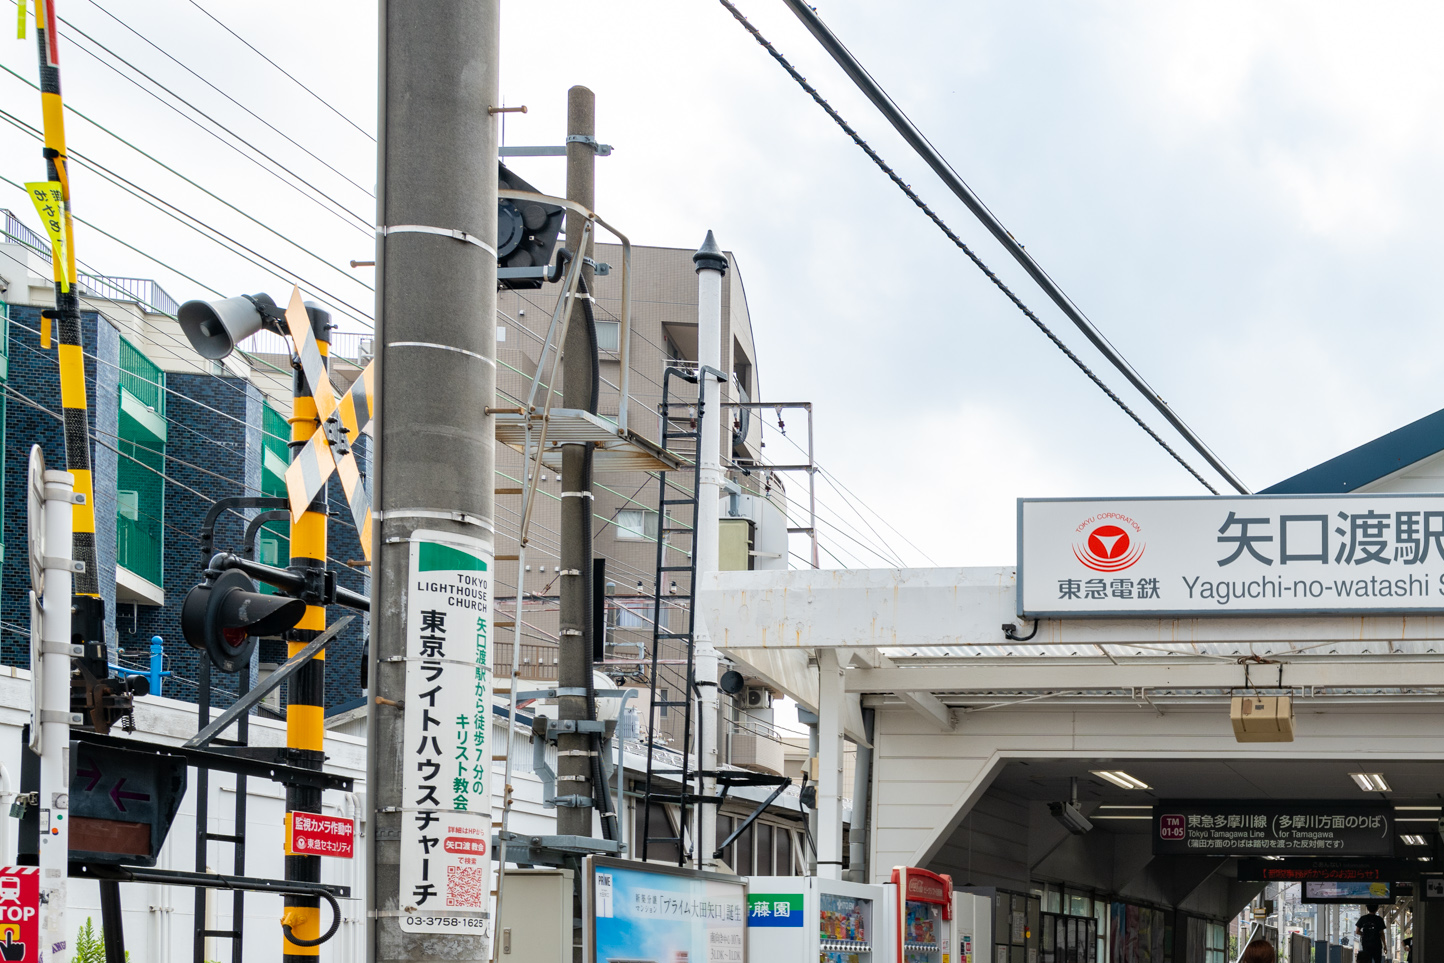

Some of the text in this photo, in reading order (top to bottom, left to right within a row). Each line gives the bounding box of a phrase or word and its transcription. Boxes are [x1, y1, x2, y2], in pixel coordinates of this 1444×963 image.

[1075, 512, 1142, 533] TOKYU CORPORATION
[457, 573, 488, 590] TOKYO
[1057, 577, 1161, 600] 東急電鉄
[1182, 574, 1429, 605] Yaguchi-no-watashi
[417, 581, 488, 602] LIGHTHOUSE
[448, 596, 488, 613] CHURCH
[472, 616, 488, 795] 矢口渡駅から徒歩7分の
[413, 609, 447, 906] 東京ライトハウスチャーチ
[453, 714, 470, 811] キリスト教会
[295, 816, 353, 837] 監視カメラ作動中
[1167, 818, 1180, 826] TM
[1188, 814, 1268, 829] 東急多摩川線
[447, 826, 485, 837] 詳細はHPから
[1161, 828, 1184, 837] 01-05
[1210, 830, 1249, 839] Tamagawa
[1249, 829, 1265, 838] Line
[1278, 829, 1290, 838] for
[1292, 830, 1334, 839] Tamagawa
[307, 838, 352, 853] 東急セキュリティ
[445, 840, 484, 852] 矢口渡 教会
[457, 856, 477, 865] で検索
[0, 906, 36, 922] TOP
[660, 895, 742, 921] 「プライム大田矢口」誕生
[747, 900, 790, 918] 藤園
[406, 916, 484, 928] 03-3758-1625
